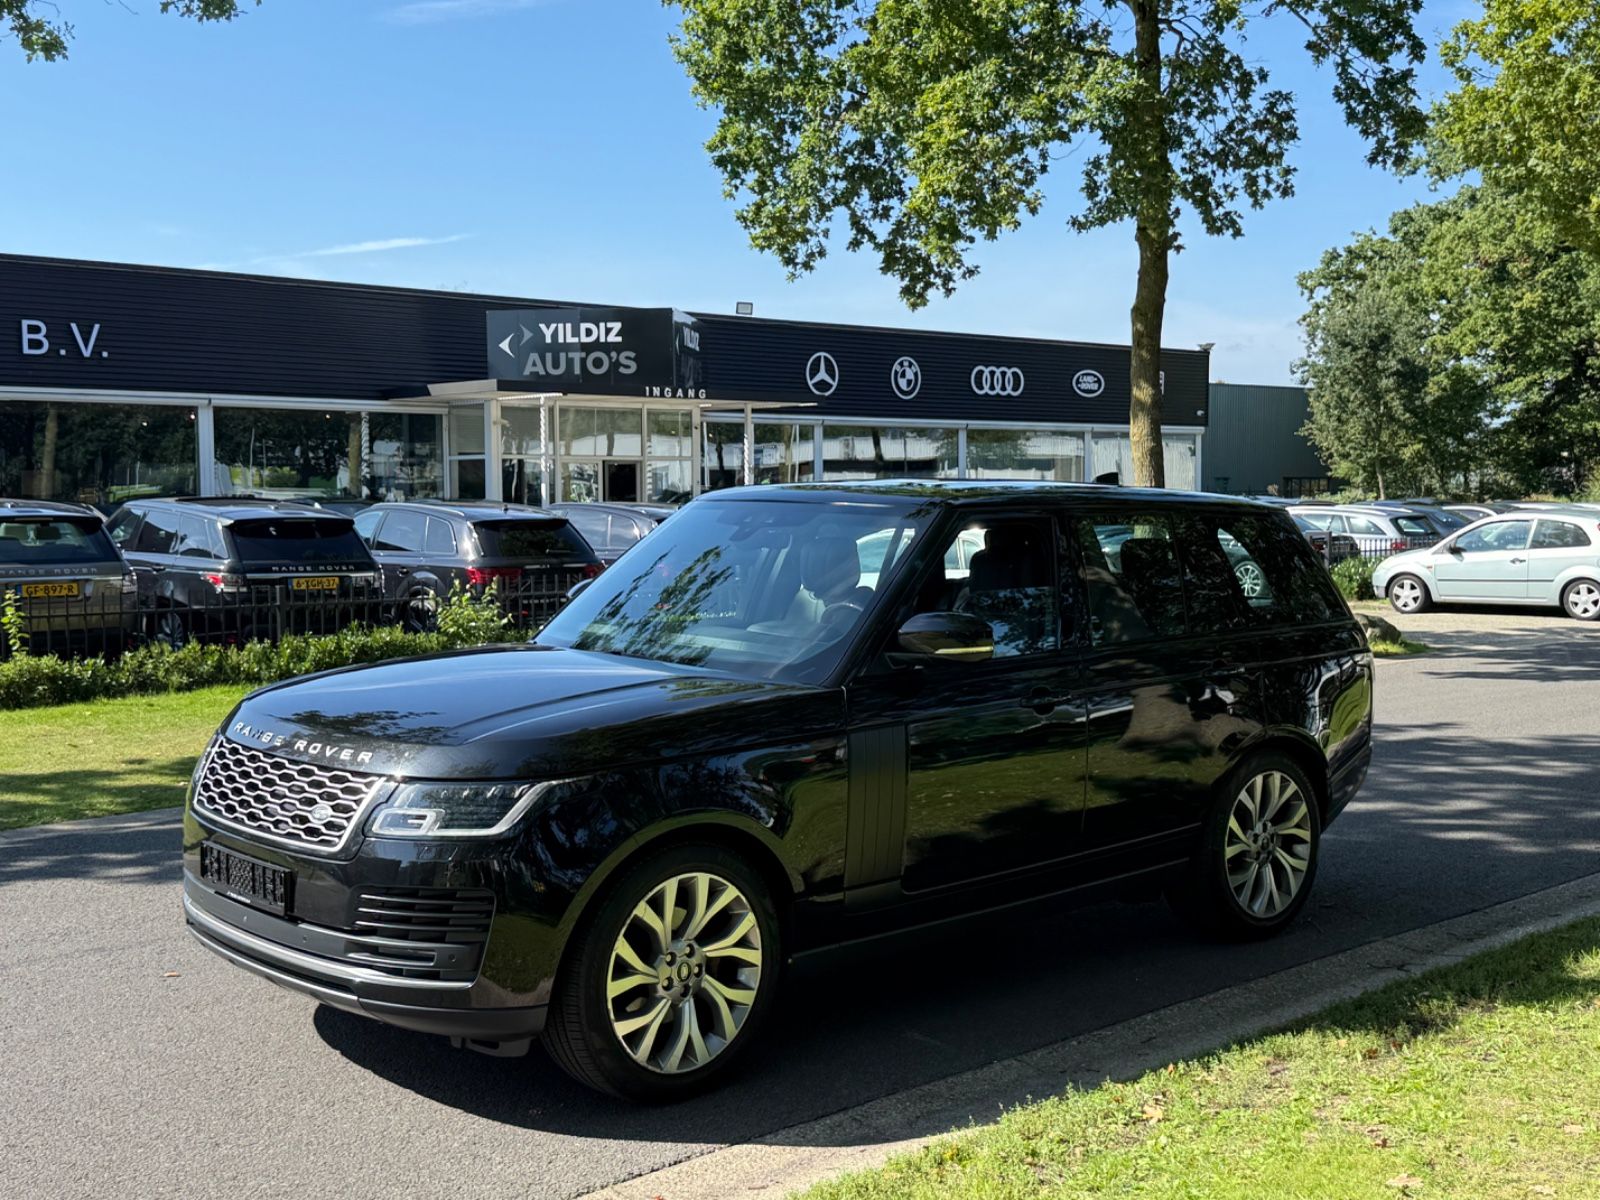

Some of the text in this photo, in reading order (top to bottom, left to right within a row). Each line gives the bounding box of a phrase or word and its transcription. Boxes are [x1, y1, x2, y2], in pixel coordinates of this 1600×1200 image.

[21, 319, 109, 358] B.V.
[538, 321, 622, 344] YILDIZ
[522, 350, 638, 376] AUTO'S
[645, 386, 707, 399] INGANG
[54, 567, 98, 575] ROVER
[25, 584, 75, 596] GF-897-R
[233, 721, 373, 764] RANGE ROVER
